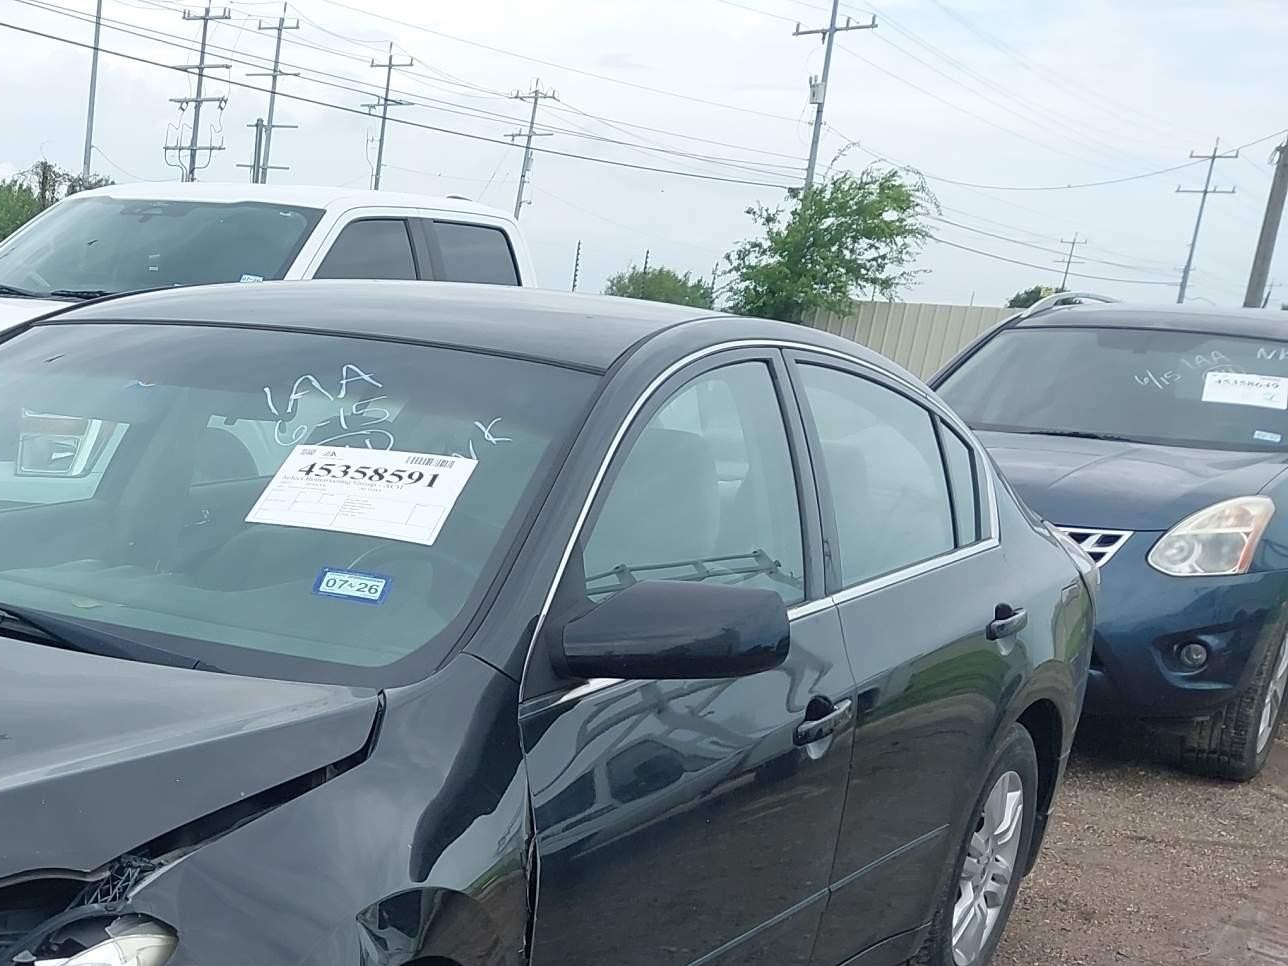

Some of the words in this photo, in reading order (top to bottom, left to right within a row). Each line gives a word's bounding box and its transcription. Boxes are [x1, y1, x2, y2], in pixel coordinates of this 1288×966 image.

[1134, 369, 1181, 389] 6/15
[274, 395, 391, 446] 6-15
[297, 462, 440, 488] 45358591
